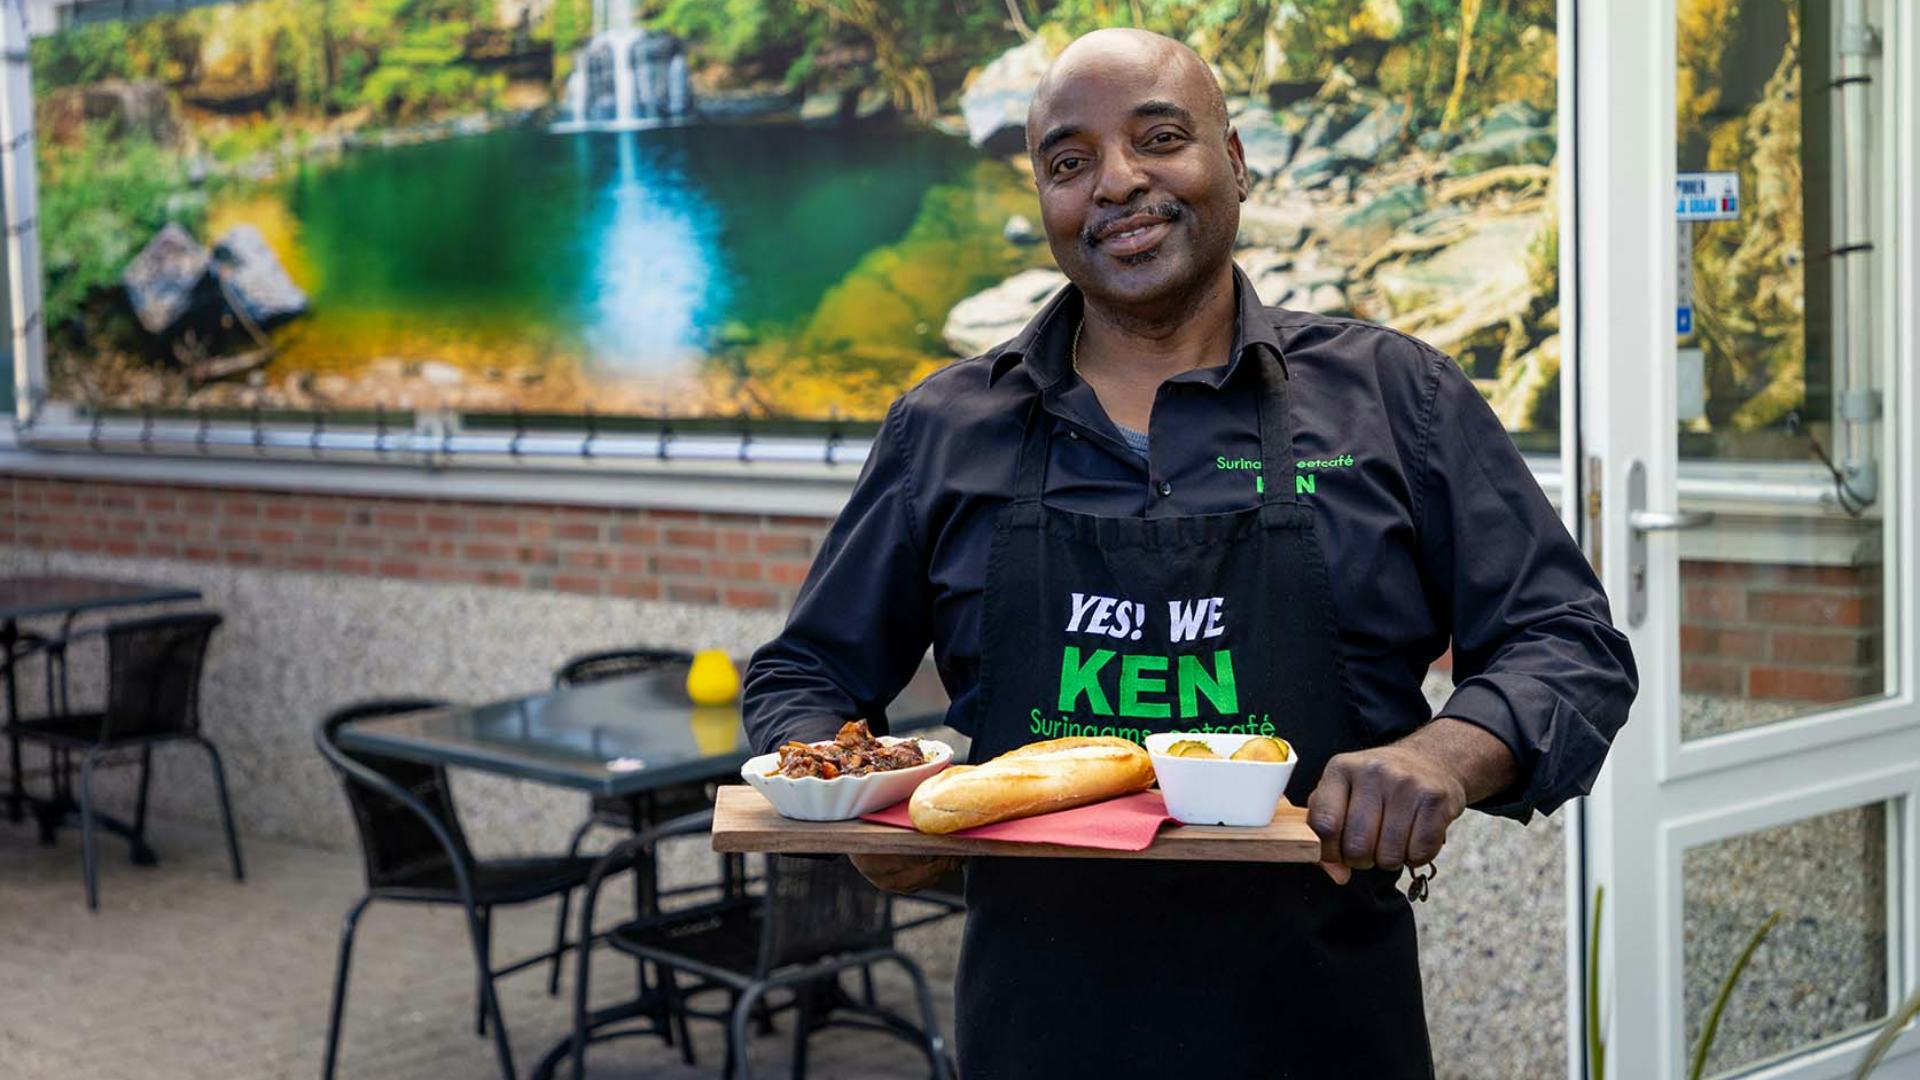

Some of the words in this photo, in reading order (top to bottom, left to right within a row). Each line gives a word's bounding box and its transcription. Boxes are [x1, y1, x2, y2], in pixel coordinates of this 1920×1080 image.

[1216, 456, 1262, 470] Surina
[1296, 454, 1355, 469] eetcafé
[1065, 592, 1146, 641] YES!
[1168, 597, 1226, 643] WE
[1057, 646, 1240, 719] KEN
